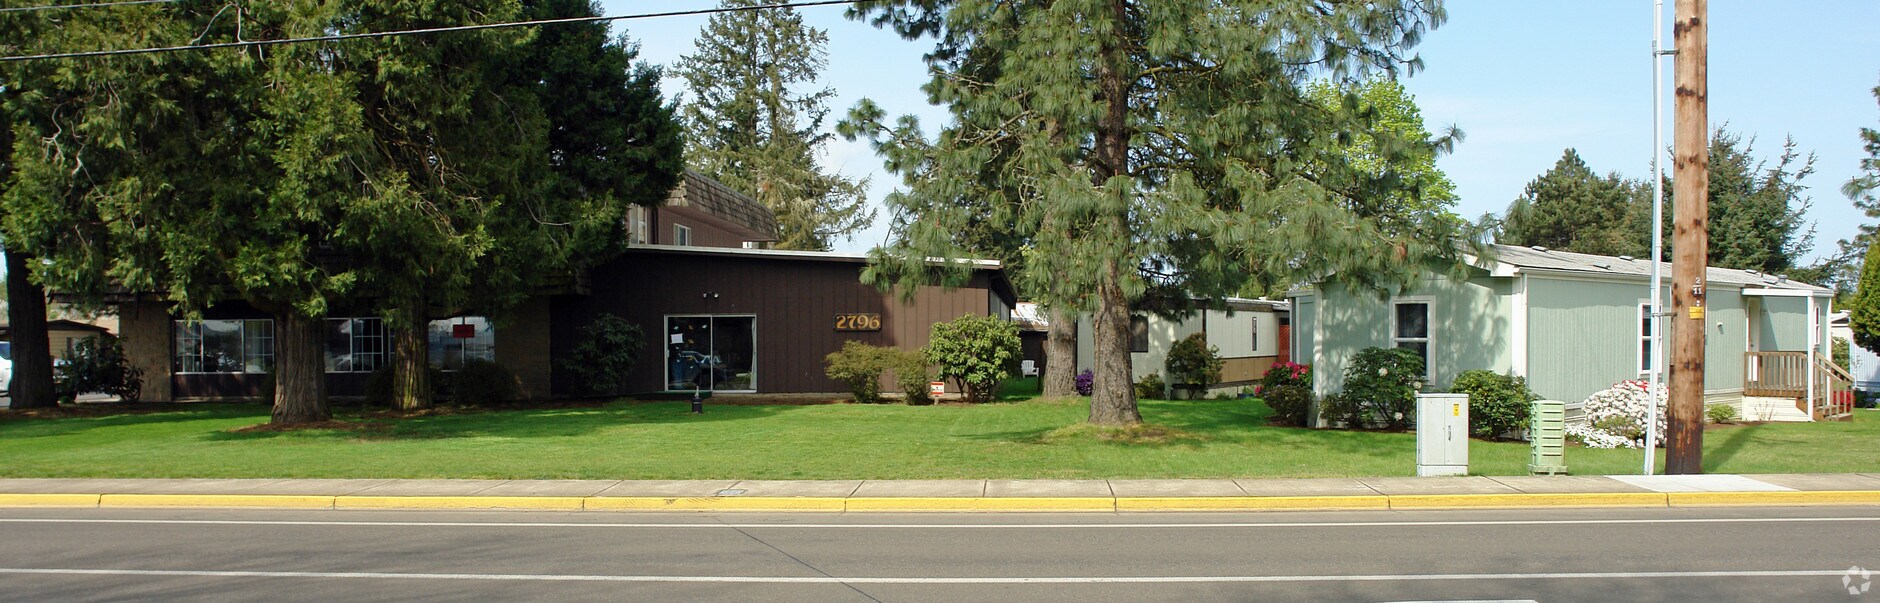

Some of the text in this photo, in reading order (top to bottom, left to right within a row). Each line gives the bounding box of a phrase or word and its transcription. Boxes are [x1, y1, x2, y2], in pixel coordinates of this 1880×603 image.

[1695, 276, 1701, 284] 2
[1693, 287, 1702, 295] 11
[836, 314, 880, 329] 2796
